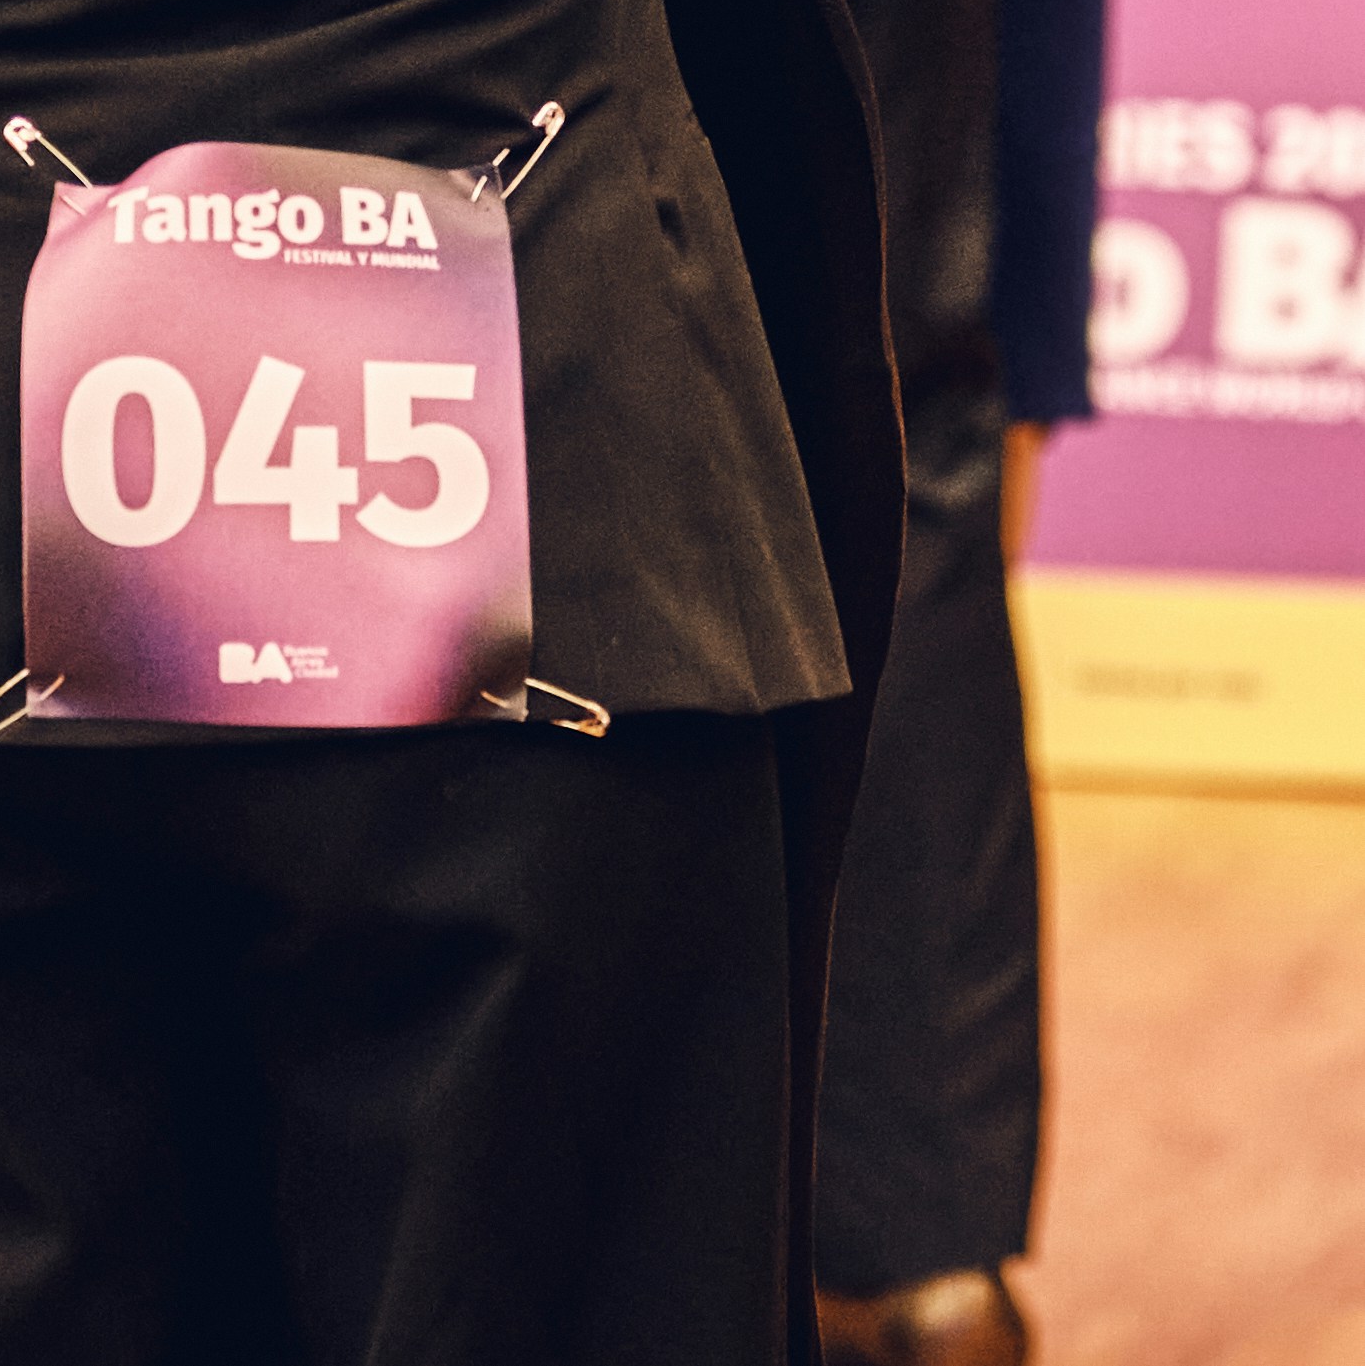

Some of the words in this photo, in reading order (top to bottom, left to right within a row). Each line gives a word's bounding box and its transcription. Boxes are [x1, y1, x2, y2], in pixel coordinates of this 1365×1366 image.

[107, 186, 324, 260] Tango
[340, 186, 438, 250] BA
[284, 248, 354, 267] FESTIVAL
[356, 249, 370, 267] Y
[371, 250, 441, 271] MUNDIAL
[1212, 197, 1365, 363] B
[61, 355, 490, 548] 045
[219, 641, 293, 684] BA
